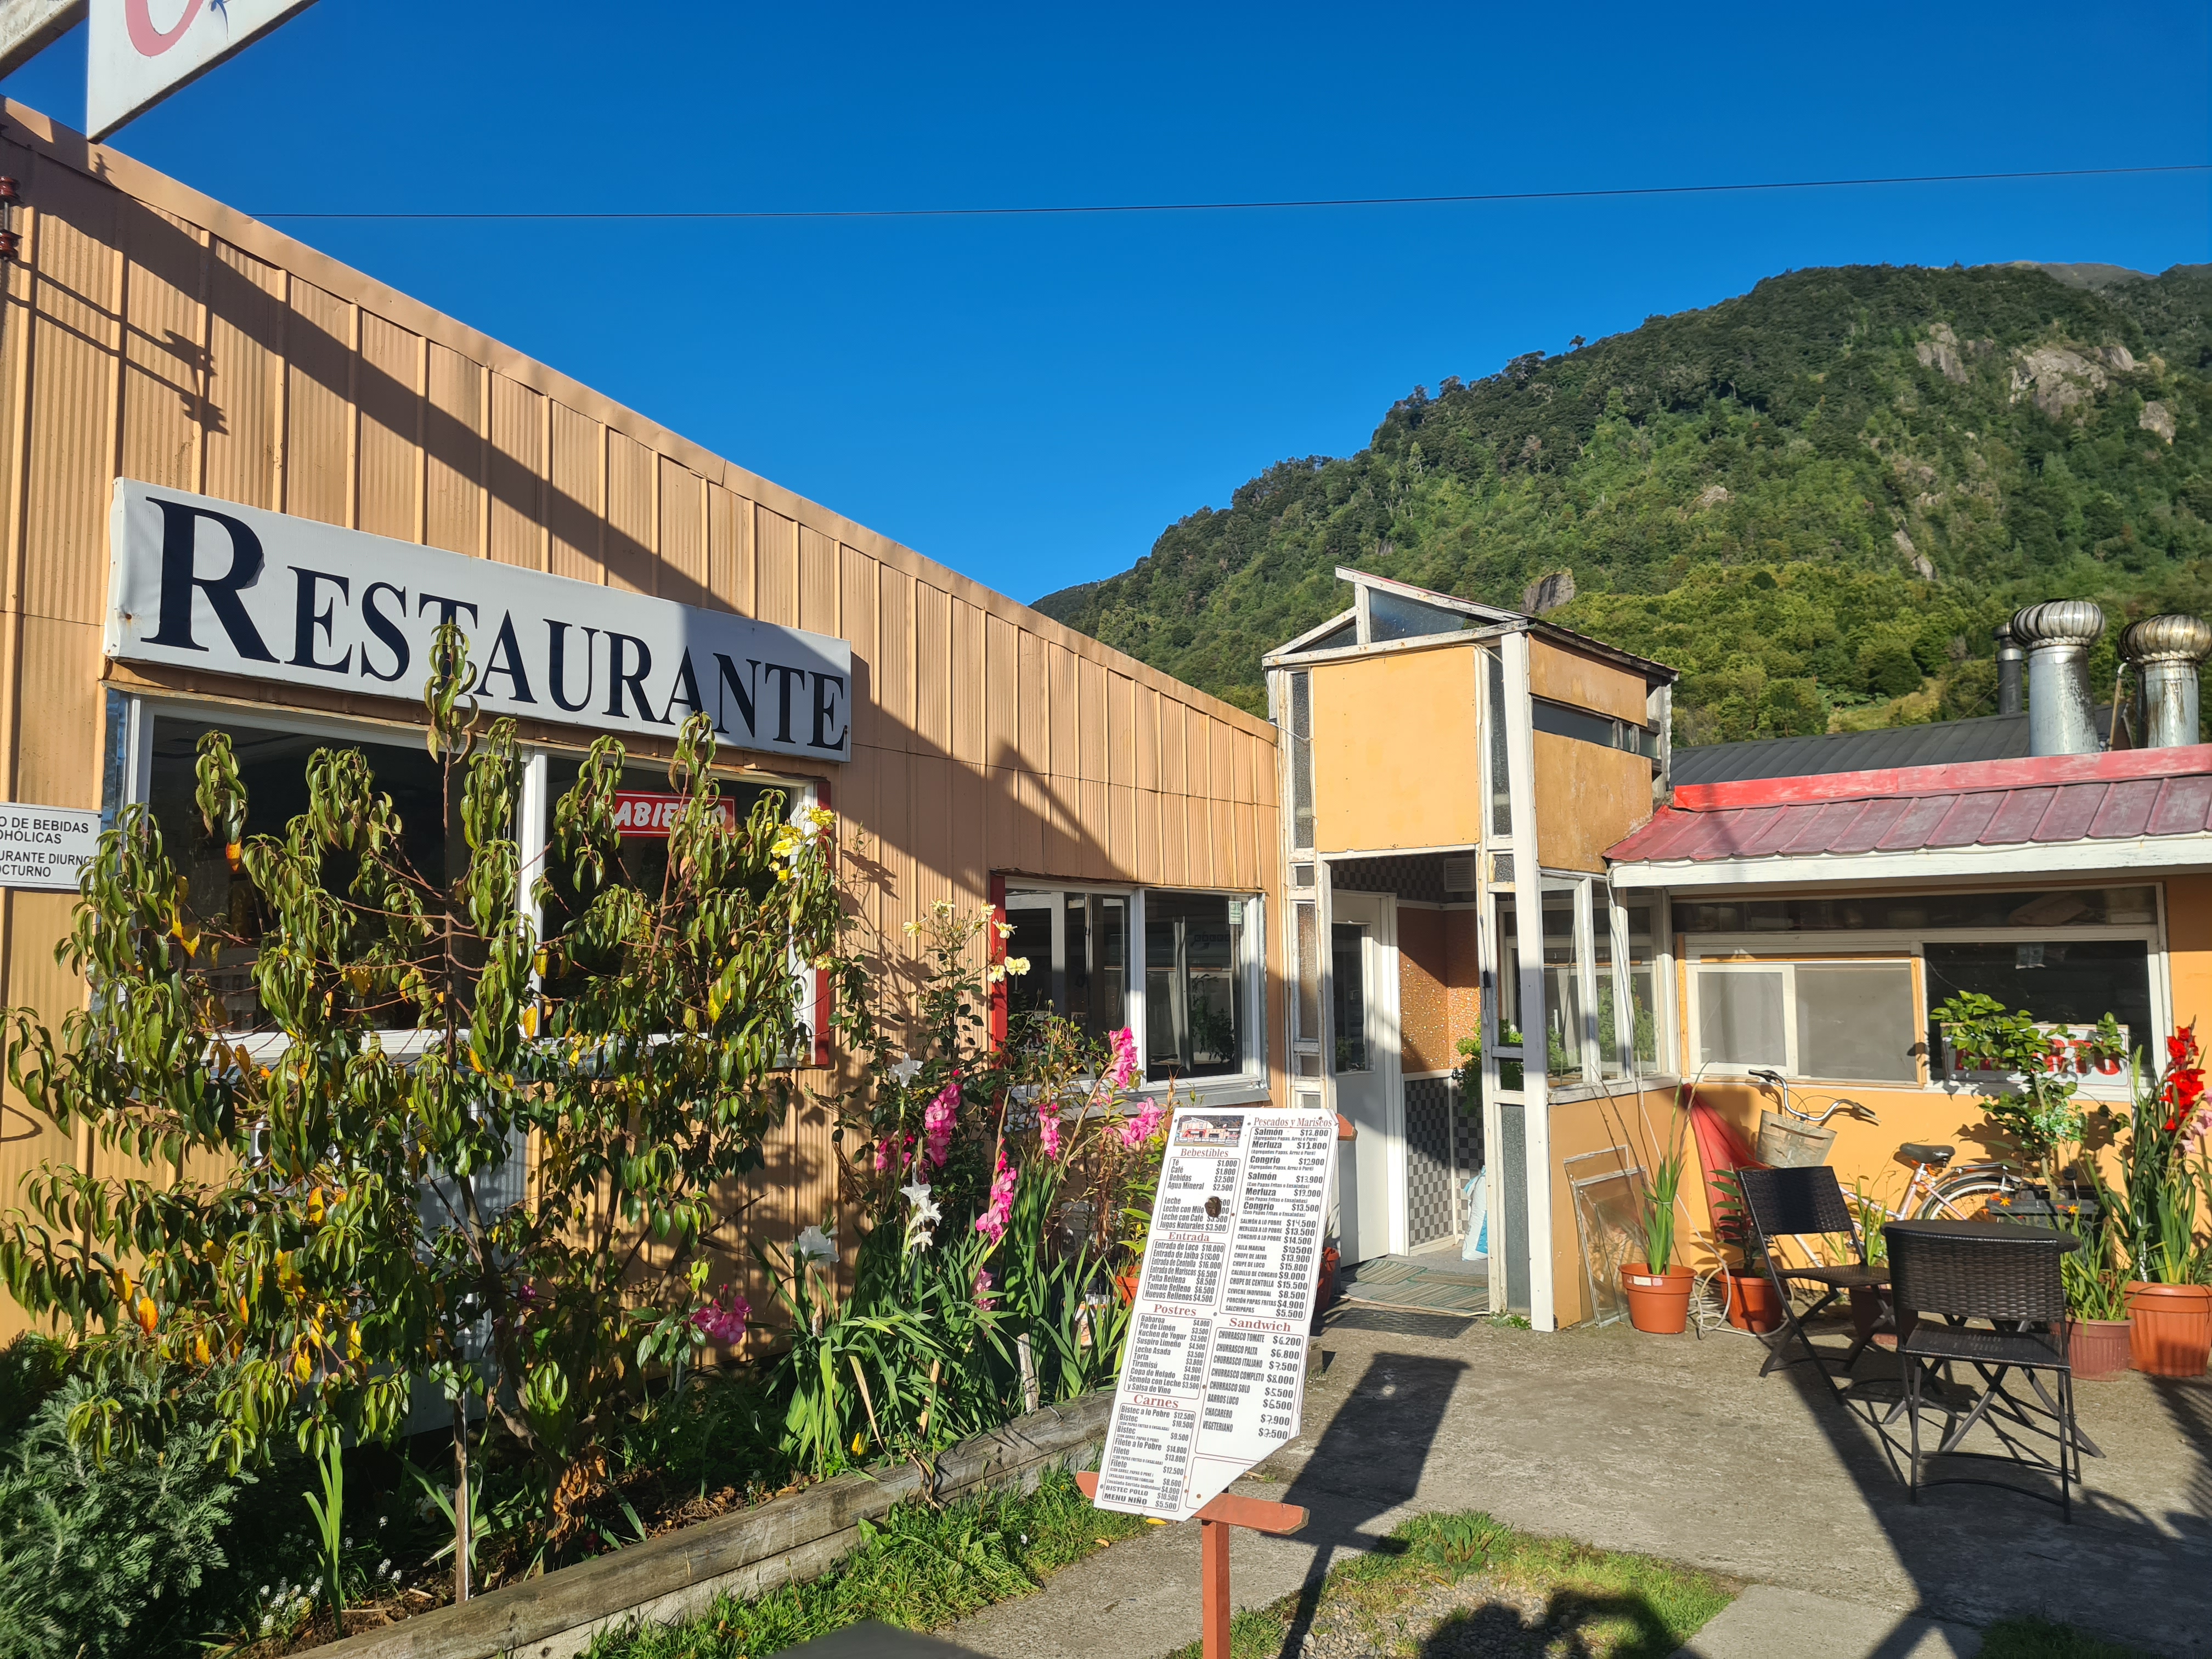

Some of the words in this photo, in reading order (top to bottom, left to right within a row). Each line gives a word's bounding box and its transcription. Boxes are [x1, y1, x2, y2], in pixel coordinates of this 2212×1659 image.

[141, 496, 845, 751] RESTAURANTE
[614, 800, 726, 827] ABIEO
[12, 817, 29, 828] DE
[33, 819, 88, 833] BEBIDAS
[0, 864, 51, 877] CTURNO
[1254, 1118, 1289, 1126] Pescados
[1297, 1117, 1332, 1127] Mariscos
[1181, 1148, 1228, 1157] Bebestibles
[1244, 1201, 1274, 1210] Congrio
[1292, 1203, 1319, 1211] $13.500
[1160, 1221, 1176, 1229] Jugos
[1177, 1221, 1204, 1229] Naturales
[1169, 1232, 1209, 1242] Entrada
[1152, 1257, 1169, 1266] Entrada
[1176, 1259, 1195, 1267] Centolla
[1199, 1261, 1221, 1269] $16.000
[1175, 1267, 1196, 1276] Mariscos
[1164, 1275, 1186, 1283] Rellena
[1196, 1277, 1216, 1285] $8.500
[1277, 1280, 1307, 1290] $15.500
[1147, 1282, 1167, 1290] Tomate
[1169, 1284, 1190, 1292] Relleno
[1194, 1285, 1214, 1294] $6.500
[1145, 1290, 1166, 1299] Huevos
[1167, 1291, 1192, 1301] Rellenos
[1193, 1294, 1212, 1302] $4.500
[1154, 1304, 1196, 1316] Postres
[1277, 1300, 1304, 1309] $4.900
[1276, 1309, 1302, 1318] $5.500
[1229, 1318, 1290, 1331] Sandwich
[1137, 1337, 1159, 1345] Suspiro
[1218, 1330, 1246, 1340] CHURRASCO
[1247, 1333, 1265, 1342] TOMATE
[1273, 1335, 1301, 1346] $6.200
[1216, 1344, 1244, 1353] CHURRASCO
[1244, 1346, 1257, 1355] PALTA
[1271, 1348, 1299, 1359] $6.800
[1133, 1360, 1158, 1368] Tiramisú
[1214, 1355, 1241, 1365] CHURRASCO
[1242, 1358, 1262, 1368] ITALIANO
[1269, 1361, 1297, 1372] $7.500
[1128, 1375, 1150, 1384] Semola
[1211, 1368, 1239, 1379] CHURRASCO
[1240, 1372, 1264, 1381] COMPLETO
[1210, 1381, 1238, 1391] CHURRASCO
[1238, 1384, 1250, 1393] SOLO
[1134, 1395, 1178, 1408] Carnes
[1207, 1393, 1226, 1403] BARROS
[1227, 1396, 1239, 1405] LUCO
[1121, 1406, 1139, 1414] Bistec
[1153, 1409, 1170, 1418] Pobre
[1174, 1412, 1194, 1420] $12.500
[1205, 1407, 1232, 1418] CHACARERO
[1261, 1414, 1289, 1425] $7.900
[1120, 1413, 1138, 1422] Bistec
[1172, 1420, 1193, 1429] $10.500
[1203, 1421, 1233, 1432] VEGETERIANO
[1117, 1425, 1136, 1434] Bistec
[1171, 1432, 1188, 1441] $9.500
[1115, 1438, 1131, 1446] Filete
[1144, 1442, 1161, 1451] Pobre
[1166, 1445, 1187, 1454] $14.800
[1113, 1447, 1129, 1455] Filete
[1165, 1454, 1186, 1463] $13.800
[1111, 1459, 1127, 1468] Filete
[1163, 1466, 1183, 1475] $12.500
[1163, 1478, 1181, 1487] $8.600
[1161, 1486, 1180, 1494] $4.000
[1157, 1493, 1178, 1502] $10.500
[1155, 1500, 1176, 1509] $5.500
